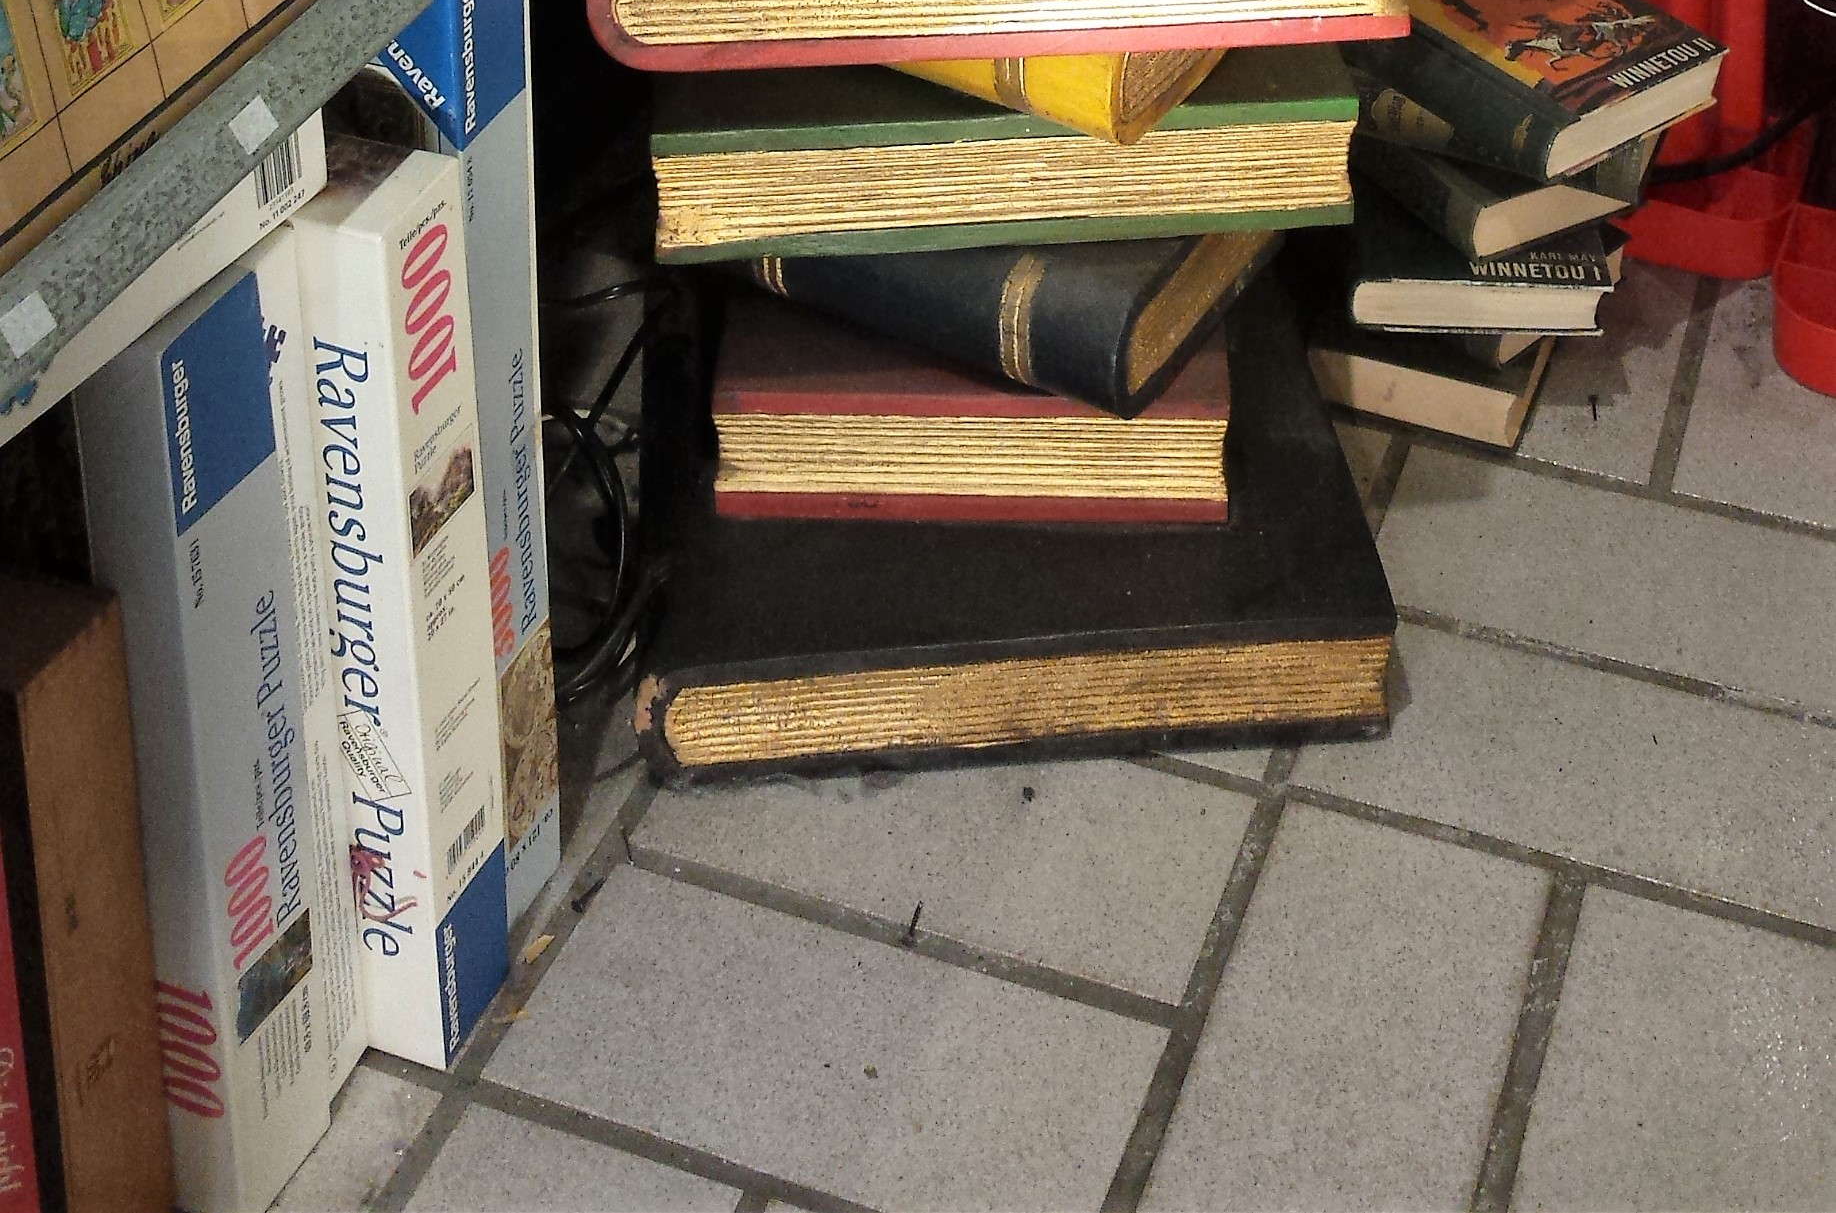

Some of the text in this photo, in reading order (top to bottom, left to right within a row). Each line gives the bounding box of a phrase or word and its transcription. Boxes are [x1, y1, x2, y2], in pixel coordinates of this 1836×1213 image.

[1606, 43, 1700, 89] WINNETOU
[400, 223, 461, 413] 1000
[1469, 260, 1586, 280] WINNETOU
[171, 358, 198, 516] Ravensburger
[507, 346, 538, 636] Ravensburger Puzzle
[249, 588, 286, 711] Puzzle
[312, 336, 386, 729] Ravensburger
[352, 790, 414, 958] Puzzle
[262, 712, 303, 928] Ravensburger
[339, 720, 387, 795] Ravensburger
[340, 739, 367, 778] Quality
[355, 723, 405, 787] Original
[224, 834, 275, 970] 1000
[156, 978, 226, 1120] 1000
[441, 923, 462, 1051] Ravensburger
